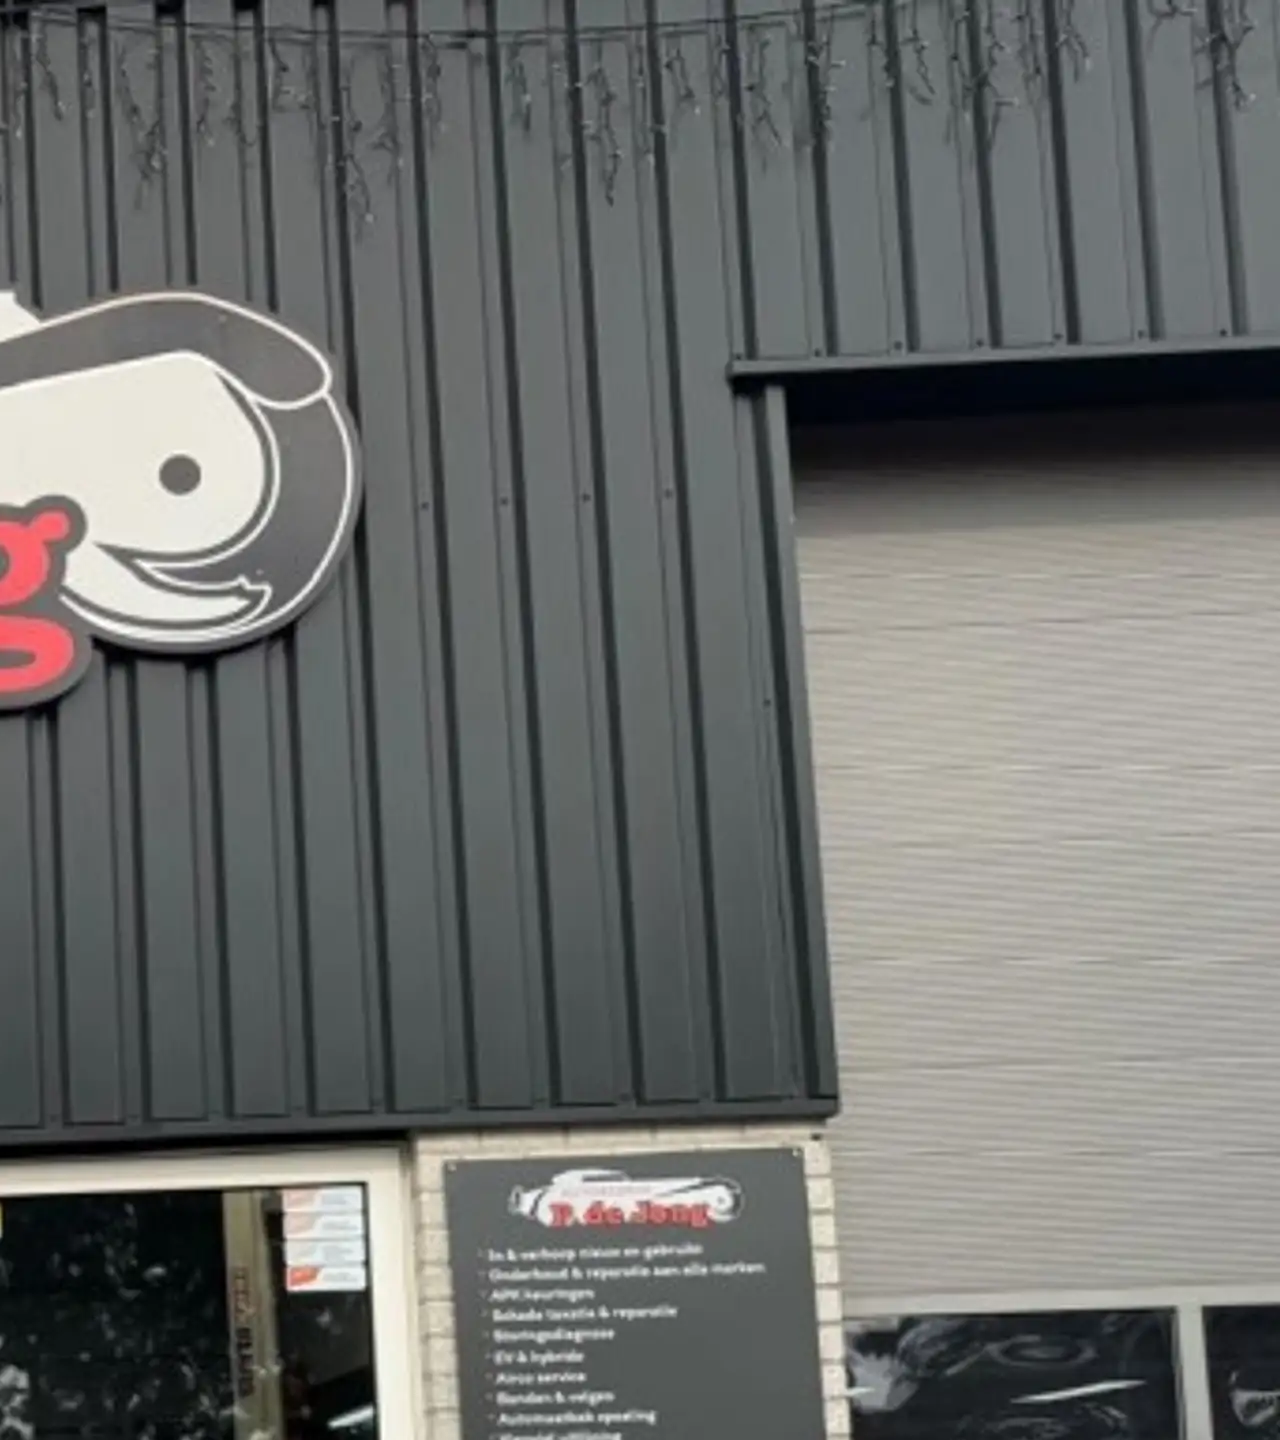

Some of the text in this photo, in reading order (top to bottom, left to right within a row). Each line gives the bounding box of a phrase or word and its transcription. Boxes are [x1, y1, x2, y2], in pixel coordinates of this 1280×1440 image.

[582, 1200, 624, 1229] de
[630, 1200, 714, 1230] Jong
[488, 1267, 569, 1282] Onderhoud
[585, 1264, 651, 1281] reparatie
[612, 1304, 678, 1321] reparatie
[537, 1371, 587, 1385] service
